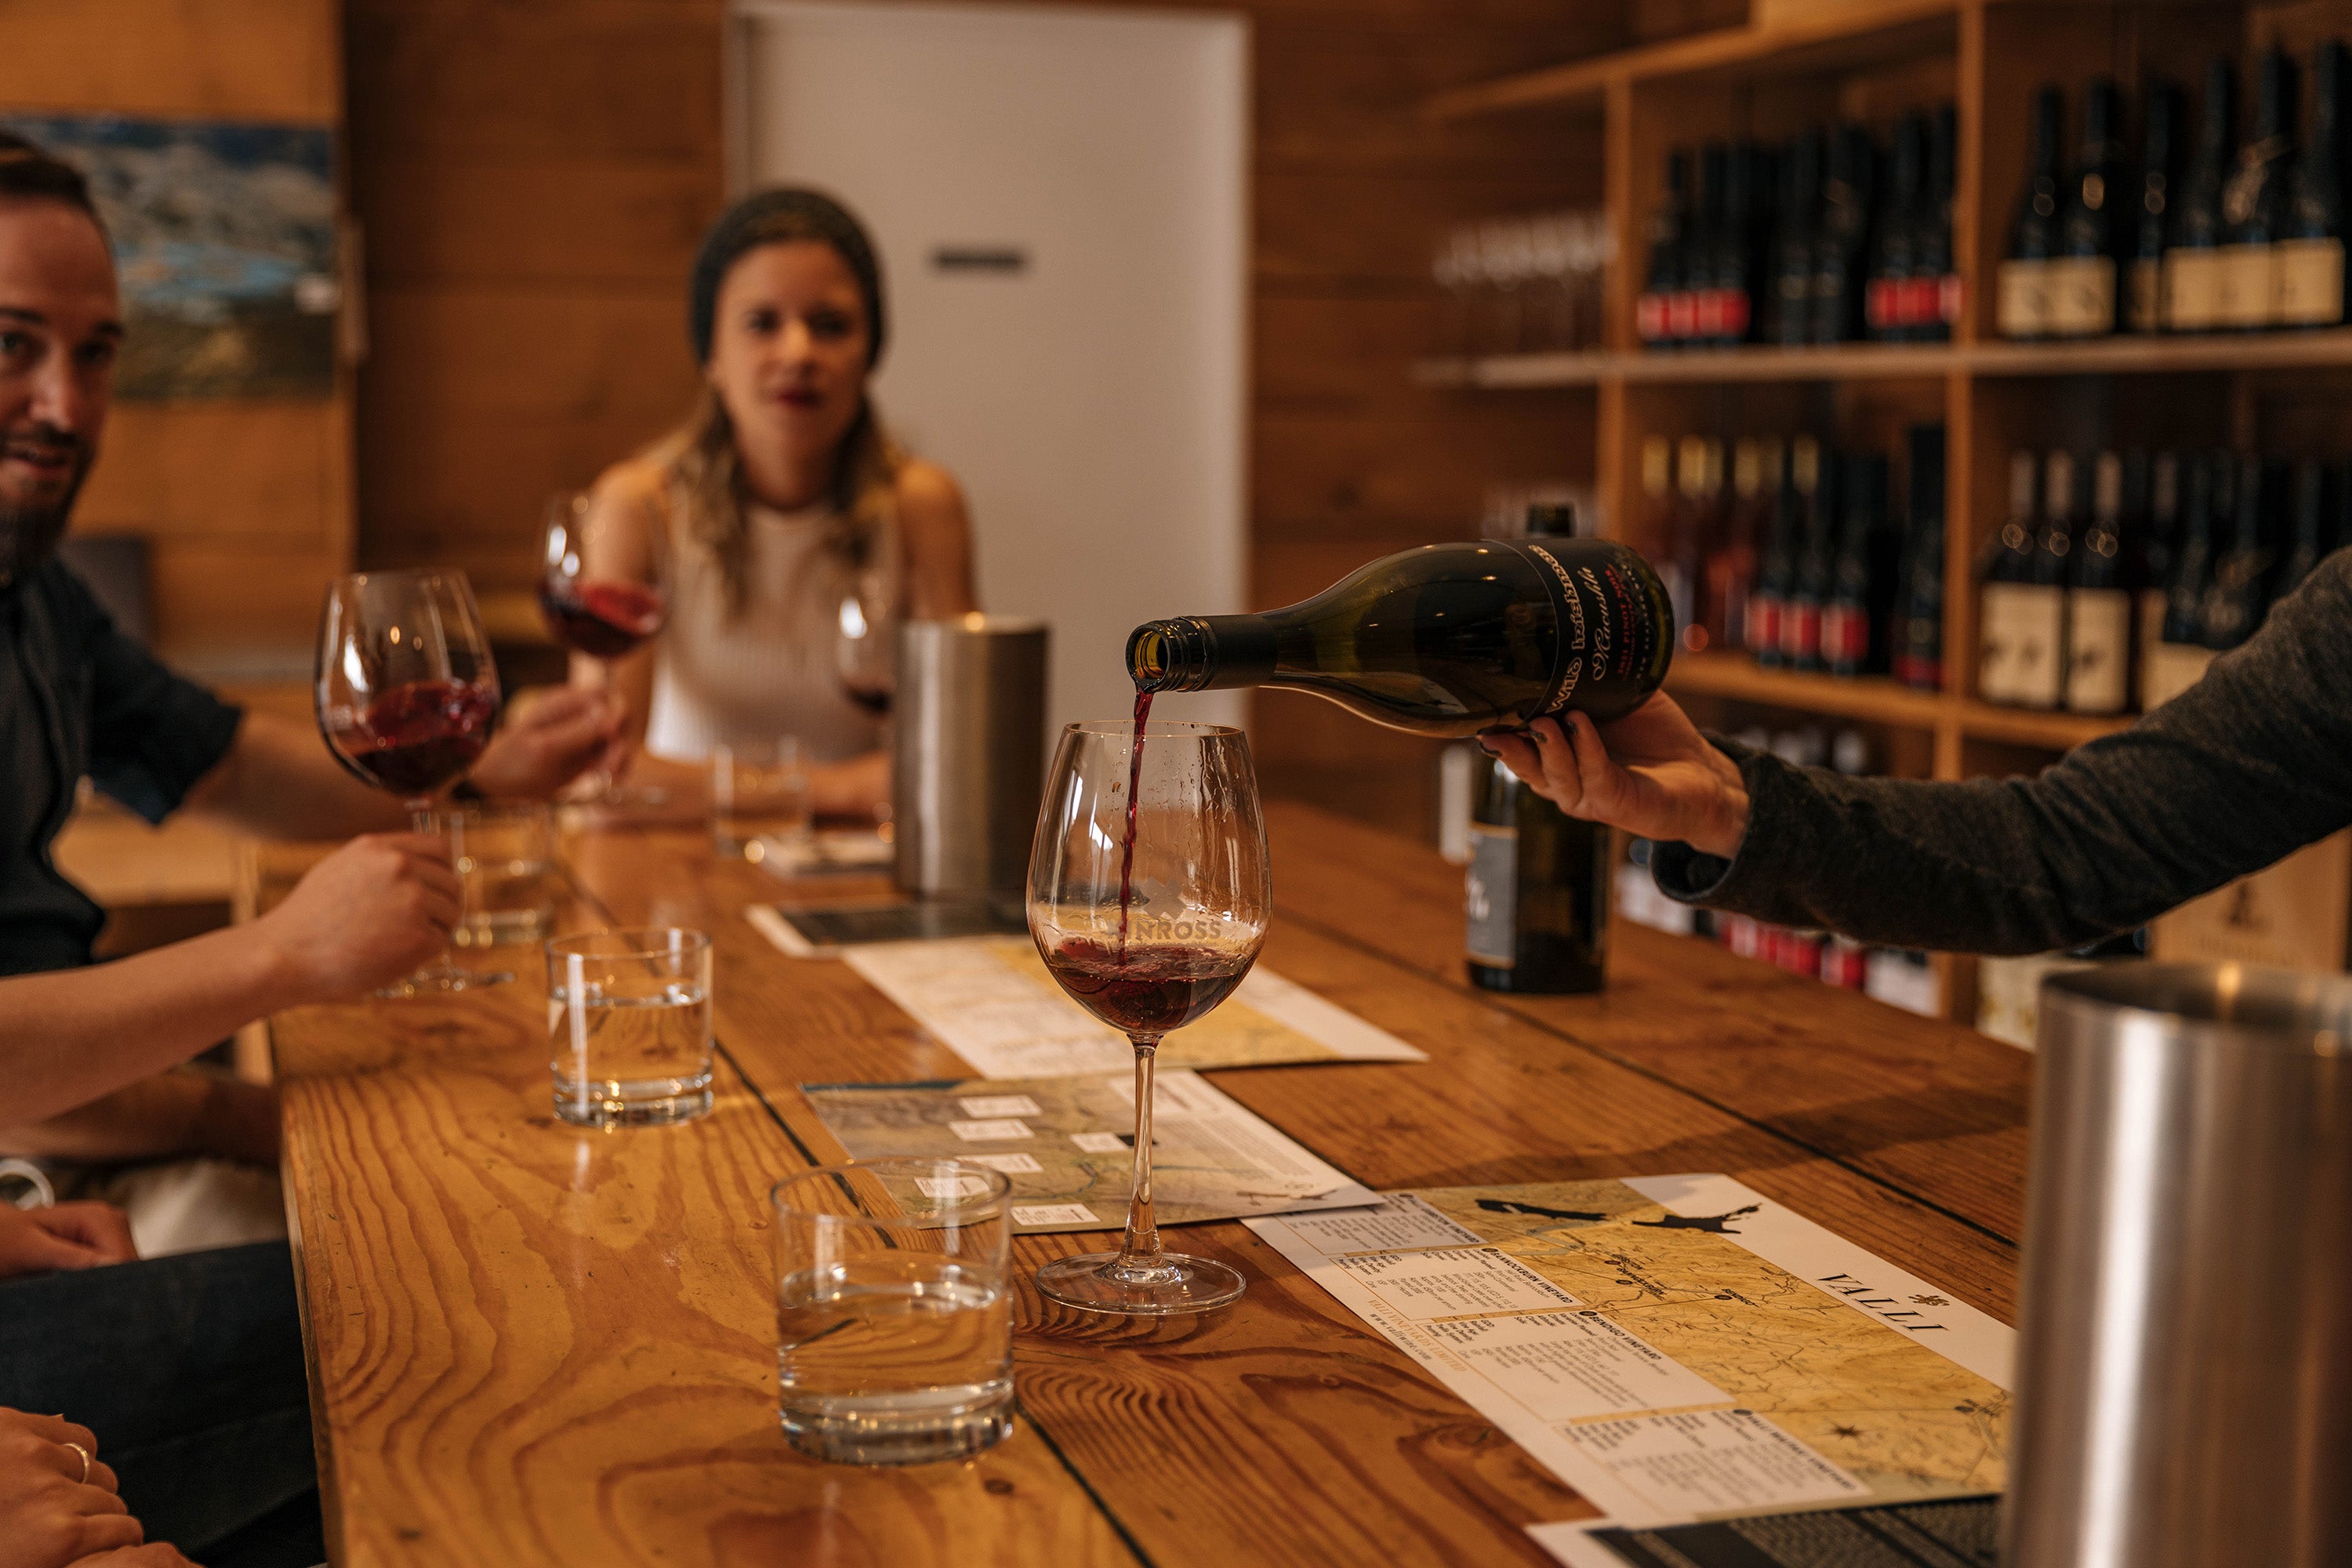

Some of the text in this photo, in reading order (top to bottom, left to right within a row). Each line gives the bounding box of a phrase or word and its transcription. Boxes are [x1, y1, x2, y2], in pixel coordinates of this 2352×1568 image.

[1577, 566, 1611, 681] Macushla
[1620, 603, 1630, 644] PINOT
[1545, 657, 1582, 713] Wild
[1490, 1253, 1573, 1303] BANNOCKBURN VINEYARD
[1721, 1288, 1756, 1306] BENDIGO
[1818, 1272, 1949, 1333] VALLI
[1368, 1299, 1466, 1371] VALLI VINEYARDS LIMITED
[1370, 1313, 1431, 1359] www.valliwine.com
[1588, 1316, 1624, 1336] BENDIGO
[1623, 1337, 1661, 1359] VINEYARD
